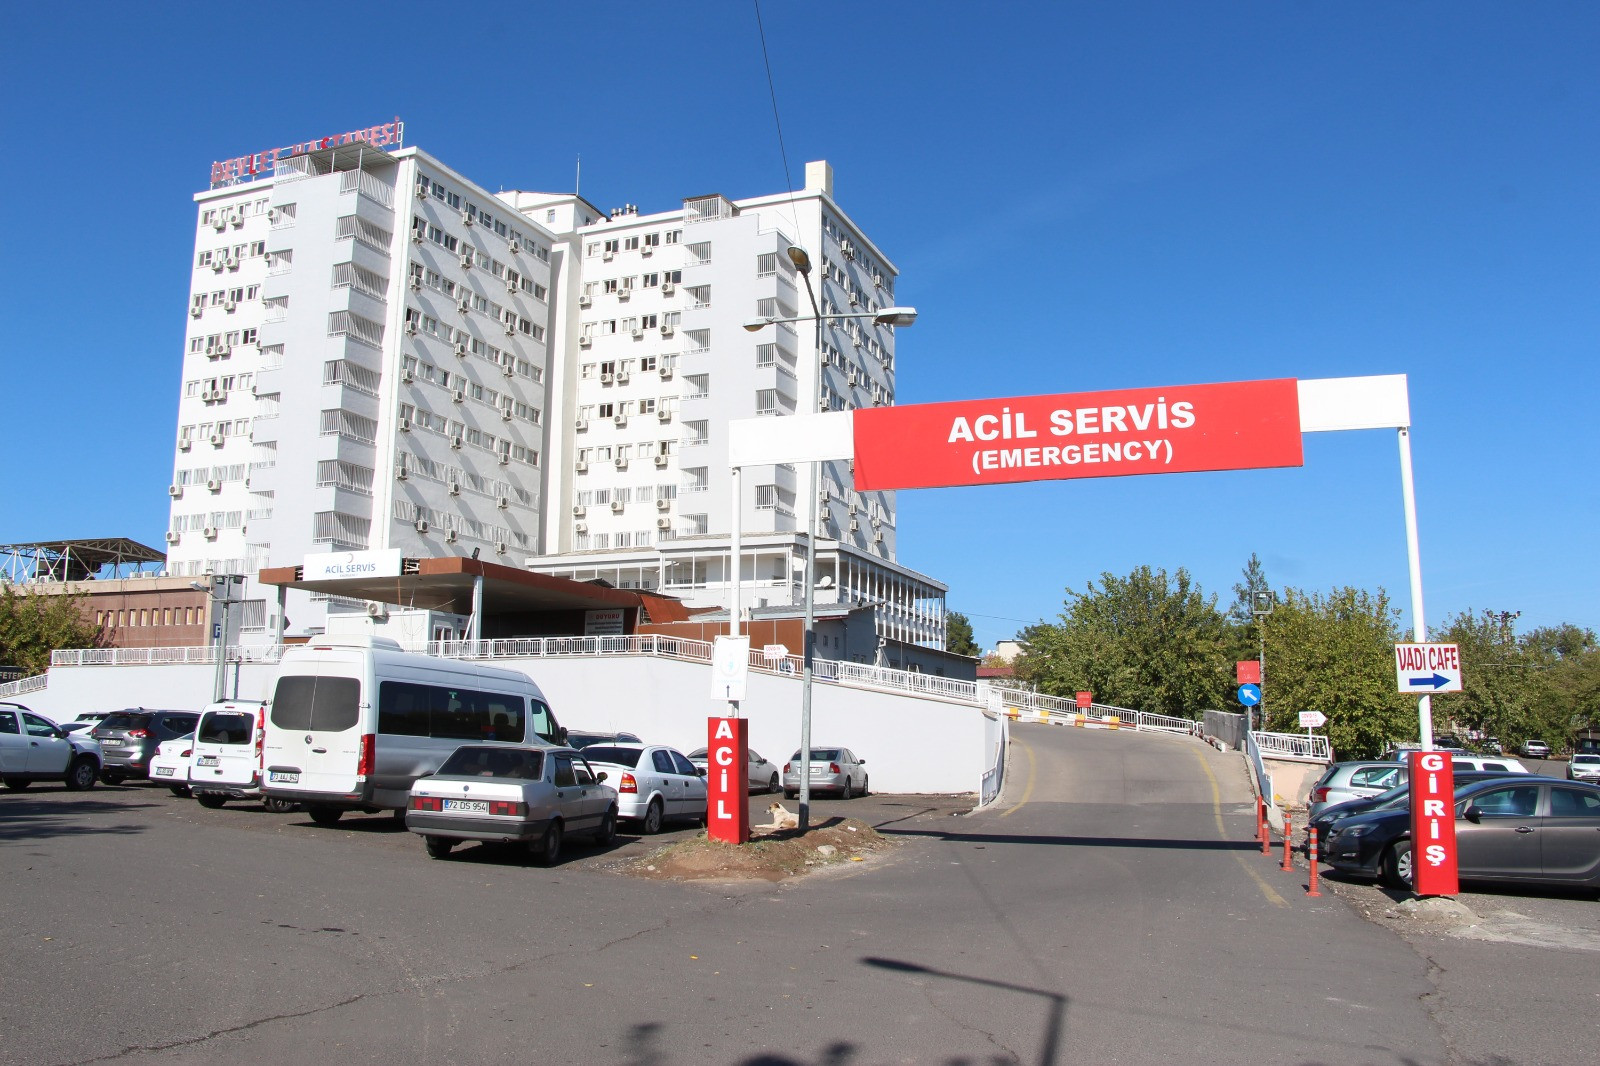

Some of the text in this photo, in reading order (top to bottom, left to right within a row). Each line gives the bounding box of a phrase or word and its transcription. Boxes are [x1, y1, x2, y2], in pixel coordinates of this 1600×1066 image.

[211, 148, 281, 183] DEVLET
[948, 397, 1196, 443] ACİL SERVİS
[972, 439, 1173, 475] (EMERGENCY)
[325, 562, 376, 574] ACİL SERVİS
[1428, 646, 1458, 671] CAFE
[714, 720, 733, 819] ACİL
[448, 801, 486, 811] 72 DS 954
[1420, 754, 1446, 866] GİRİŞ
